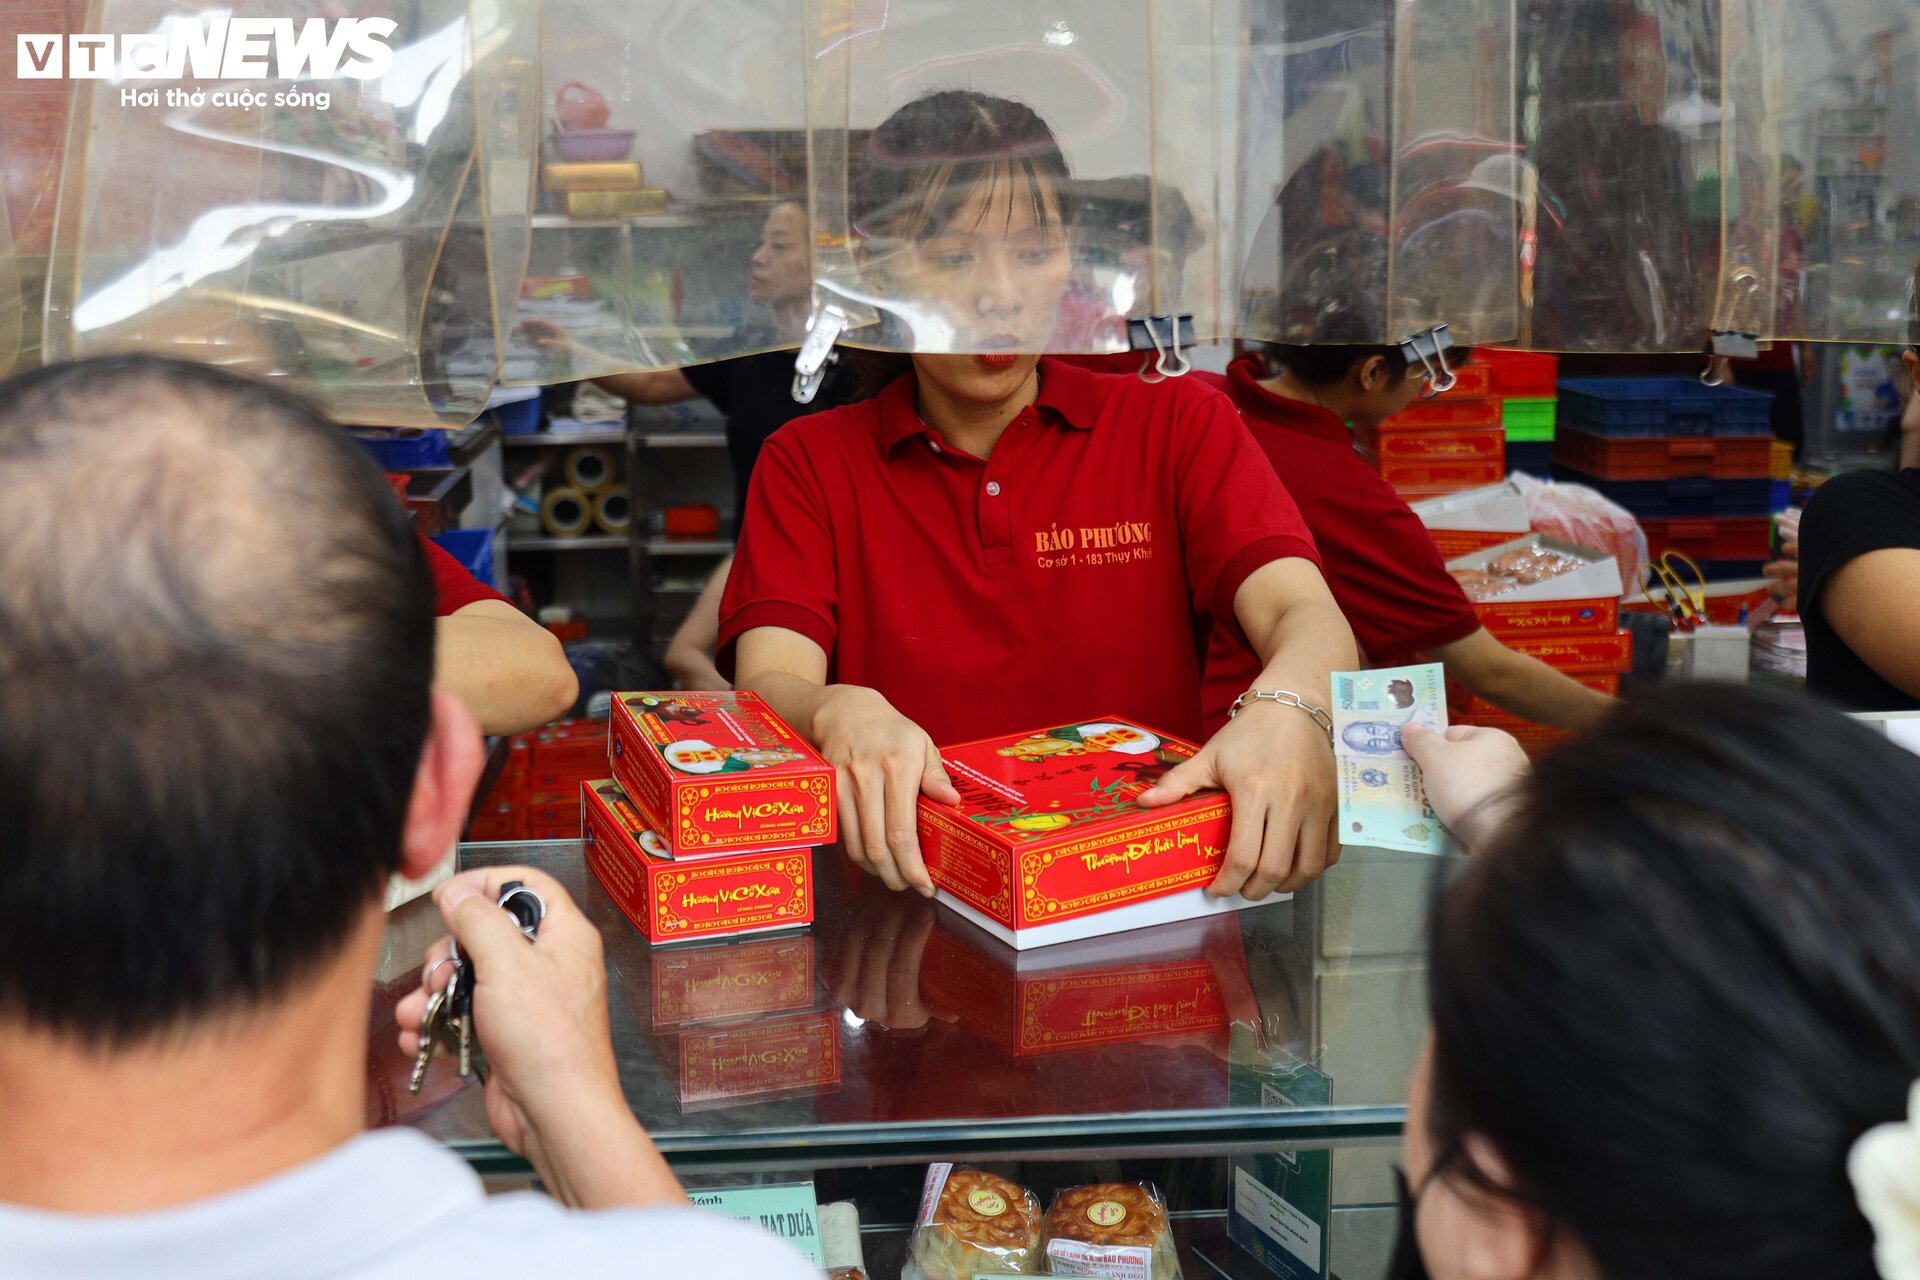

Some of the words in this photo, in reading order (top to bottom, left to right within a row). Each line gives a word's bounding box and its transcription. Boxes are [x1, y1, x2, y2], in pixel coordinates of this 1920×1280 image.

[1035, 522, 1075, 553] BẢO
[1079, 521, 1152, 549] PHƯƠNG
[1037, 557, 1054, 569] Cơ
[1070, 554, 1076, 566] 1
[1086, 553, 1103, 565] 183
[1105, 551, 1131, 564] Thụy
[787, 1208, 815, 1237] DƯA
